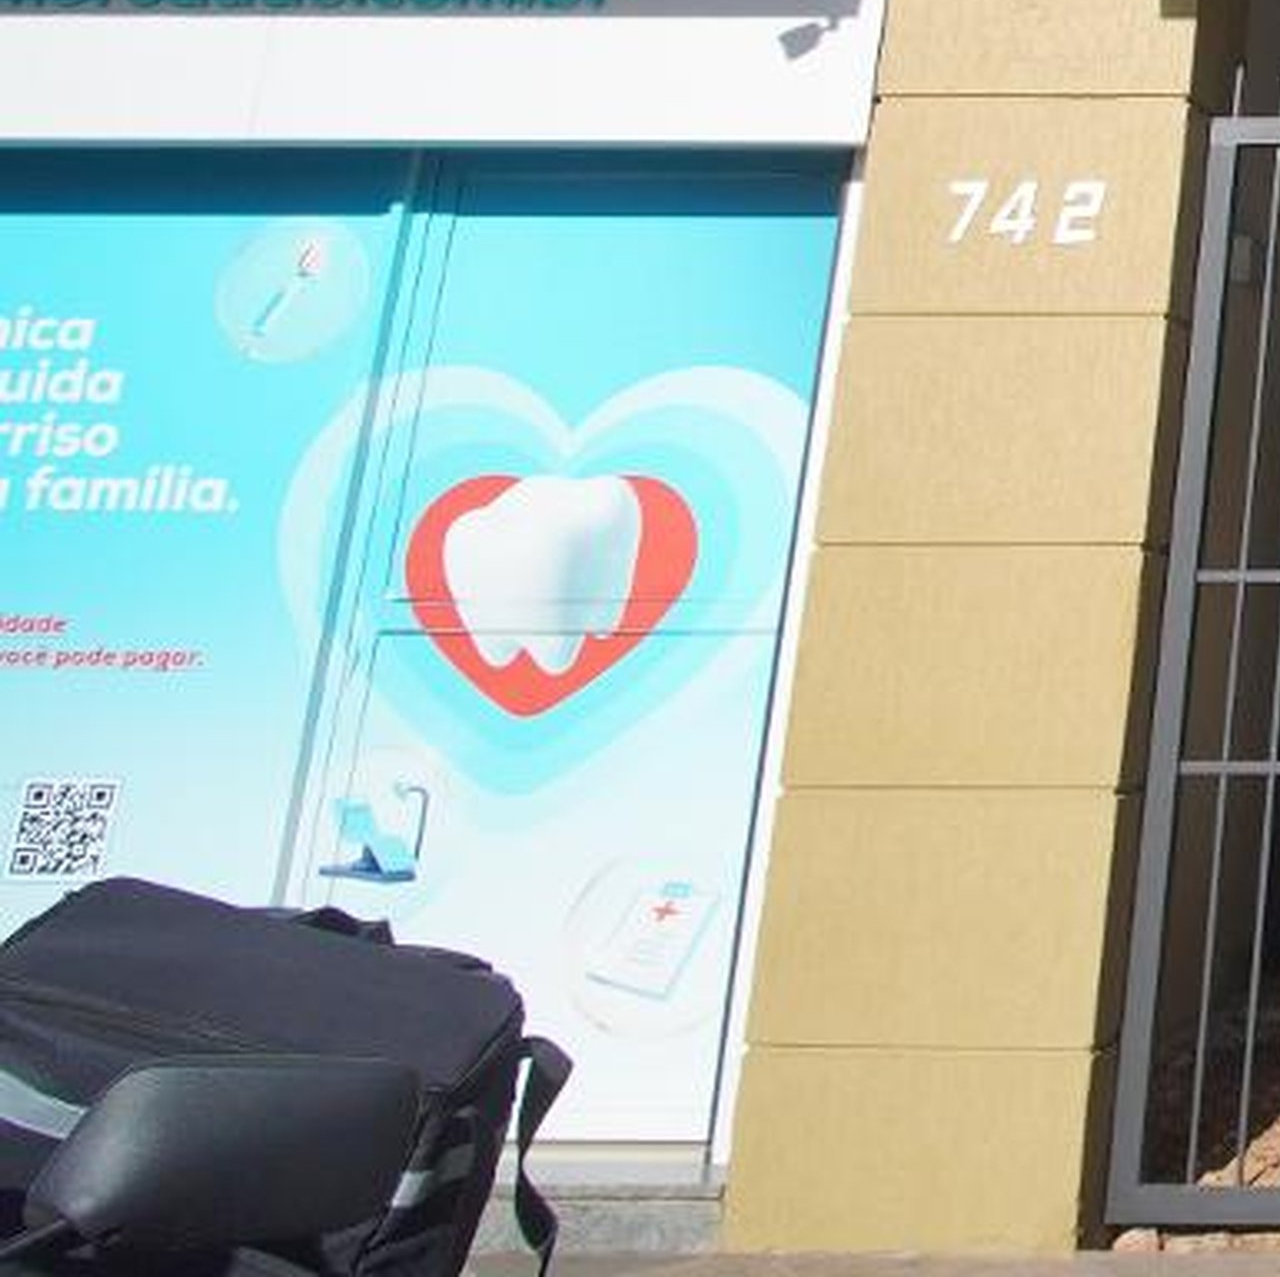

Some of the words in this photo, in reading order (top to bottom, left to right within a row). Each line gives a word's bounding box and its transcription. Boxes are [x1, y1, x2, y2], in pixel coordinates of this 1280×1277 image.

[947, 179, 1107, 246] 742
[53, 647, 118, 670] pode
[120, 650, 205, 673] pagar.
